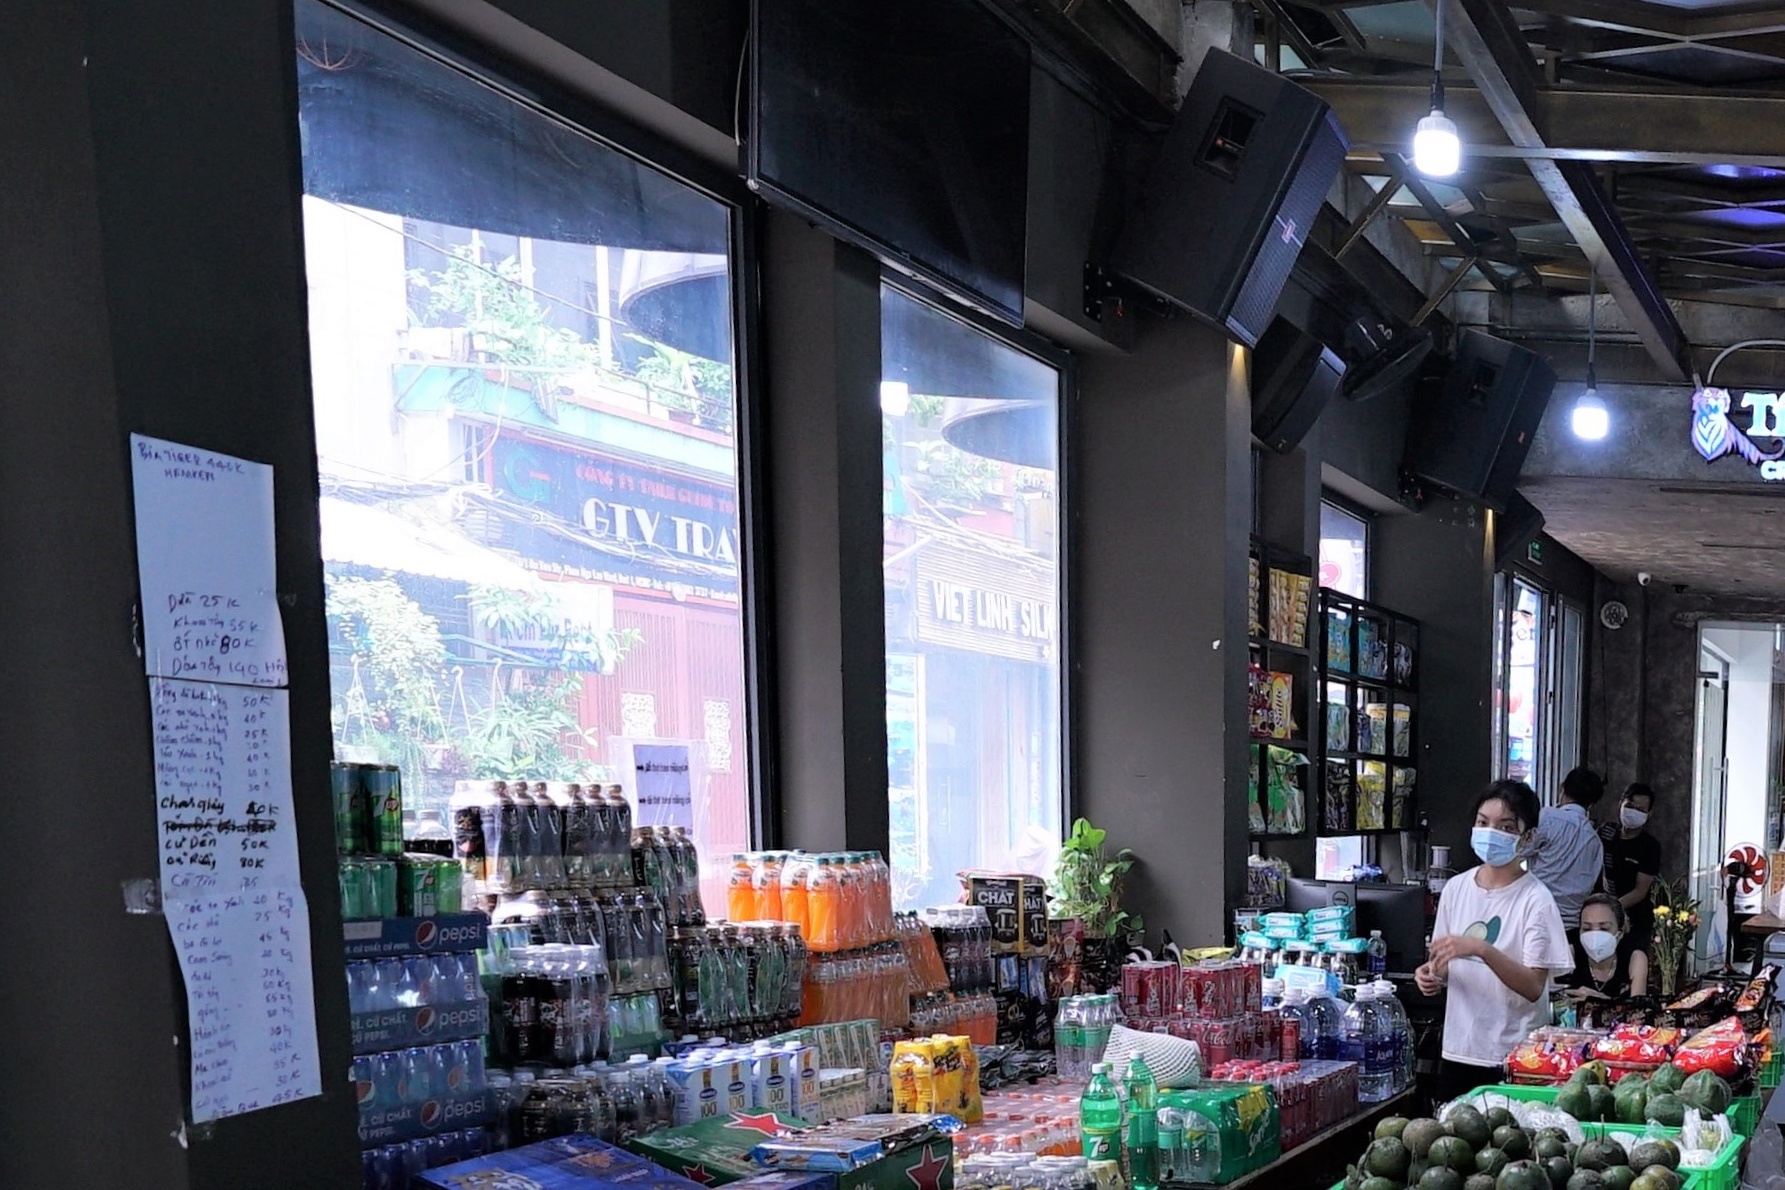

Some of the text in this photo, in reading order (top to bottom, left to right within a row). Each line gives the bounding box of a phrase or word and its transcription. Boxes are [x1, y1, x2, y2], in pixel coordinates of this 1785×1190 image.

[582, 497, 661, 549] GTV
[671, 516, 738, 563] TRA
[200, 595, 223, 608] 25
[933, 579, 973, 624] VIET
[976, 589, 1014, 632] LINH
[977, 890, 1015, 905] CHAT
[1023, 897, 1042, 911] HAT
[438, 922, 482, 945] pepsi
[438, 1007, 483, 1030] pepsi
[443, 1096, 486, 1123] pepsi
